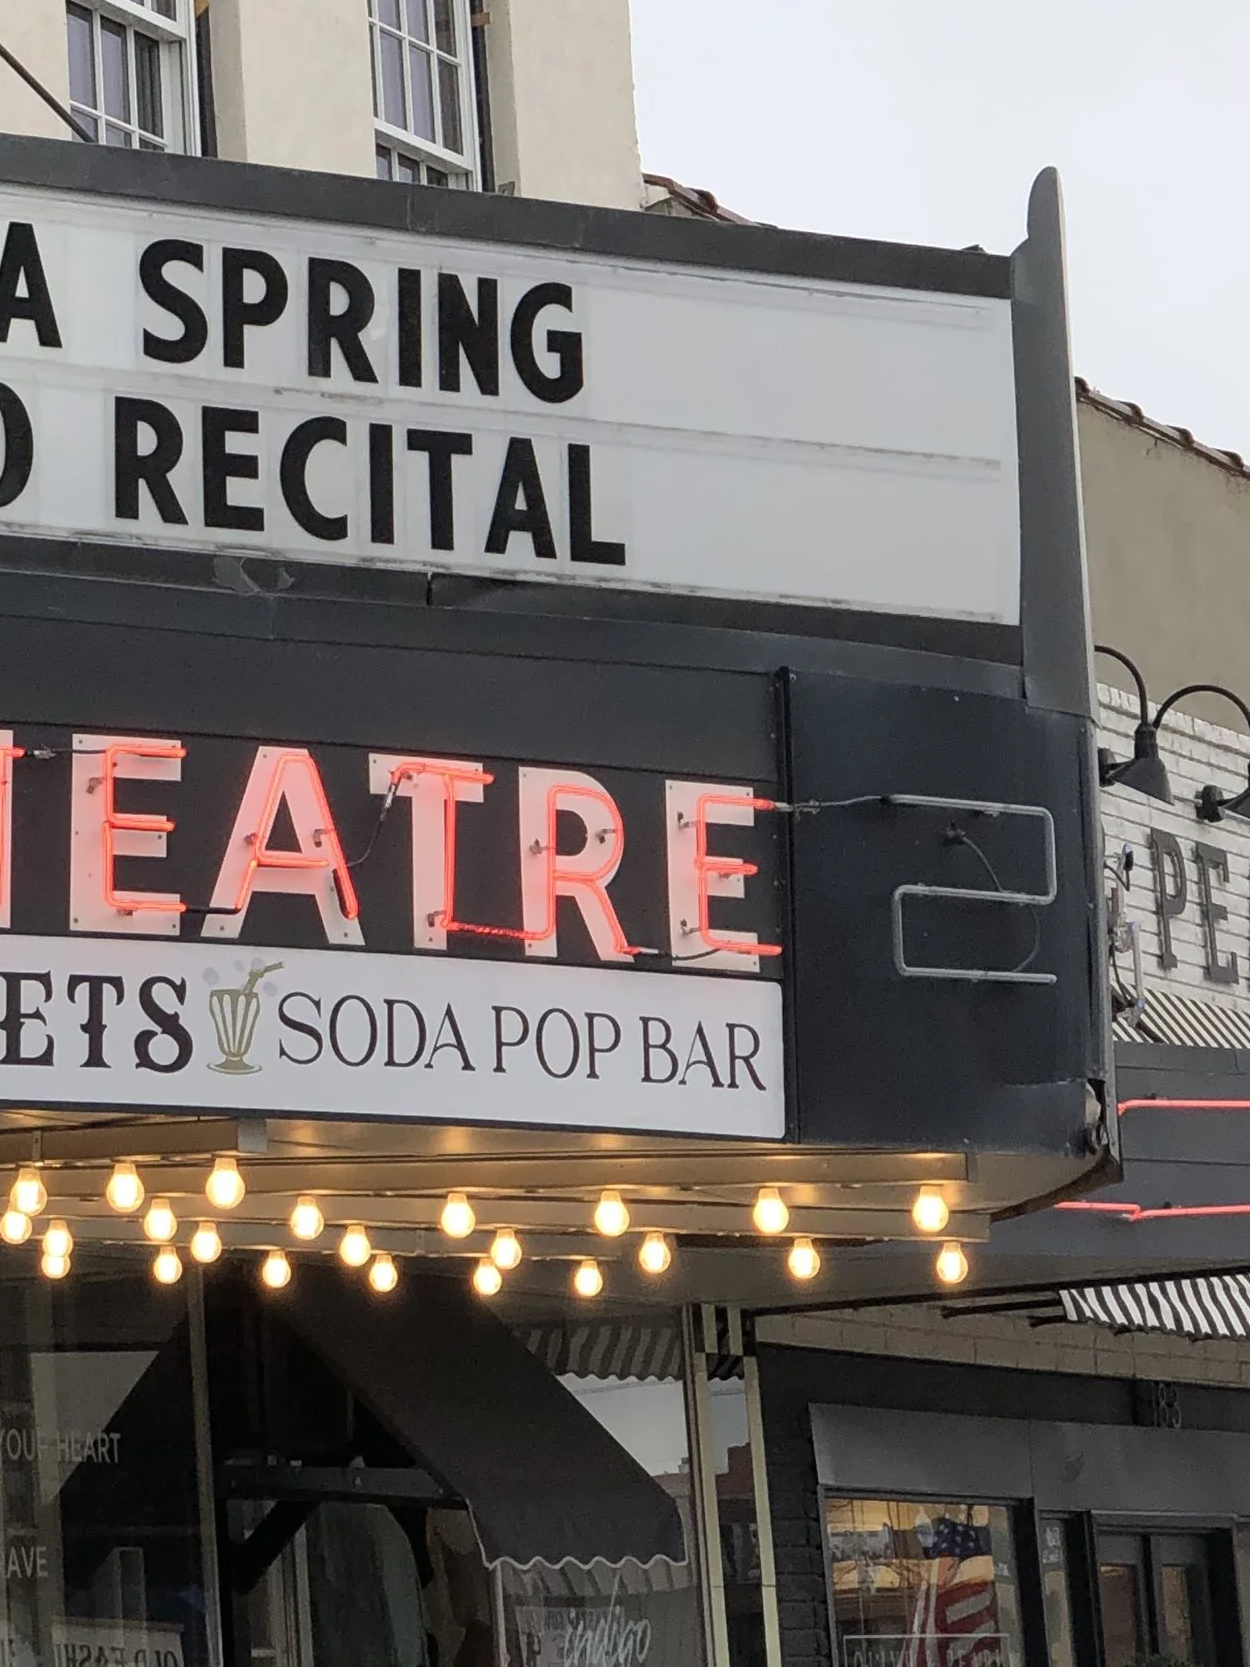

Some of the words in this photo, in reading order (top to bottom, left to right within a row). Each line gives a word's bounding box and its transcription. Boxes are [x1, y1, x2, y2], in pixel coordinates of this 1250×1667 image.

[140, 238, 584, 404] SPRING
[115, 396, 626, 566] RECITAL
[278, 992, 476, 1074] SODA
[493, 1007, 623, 1081] POP
[640, 1015, 767, 1093] BAR
[56, 1432, 122, 1463] HEART
